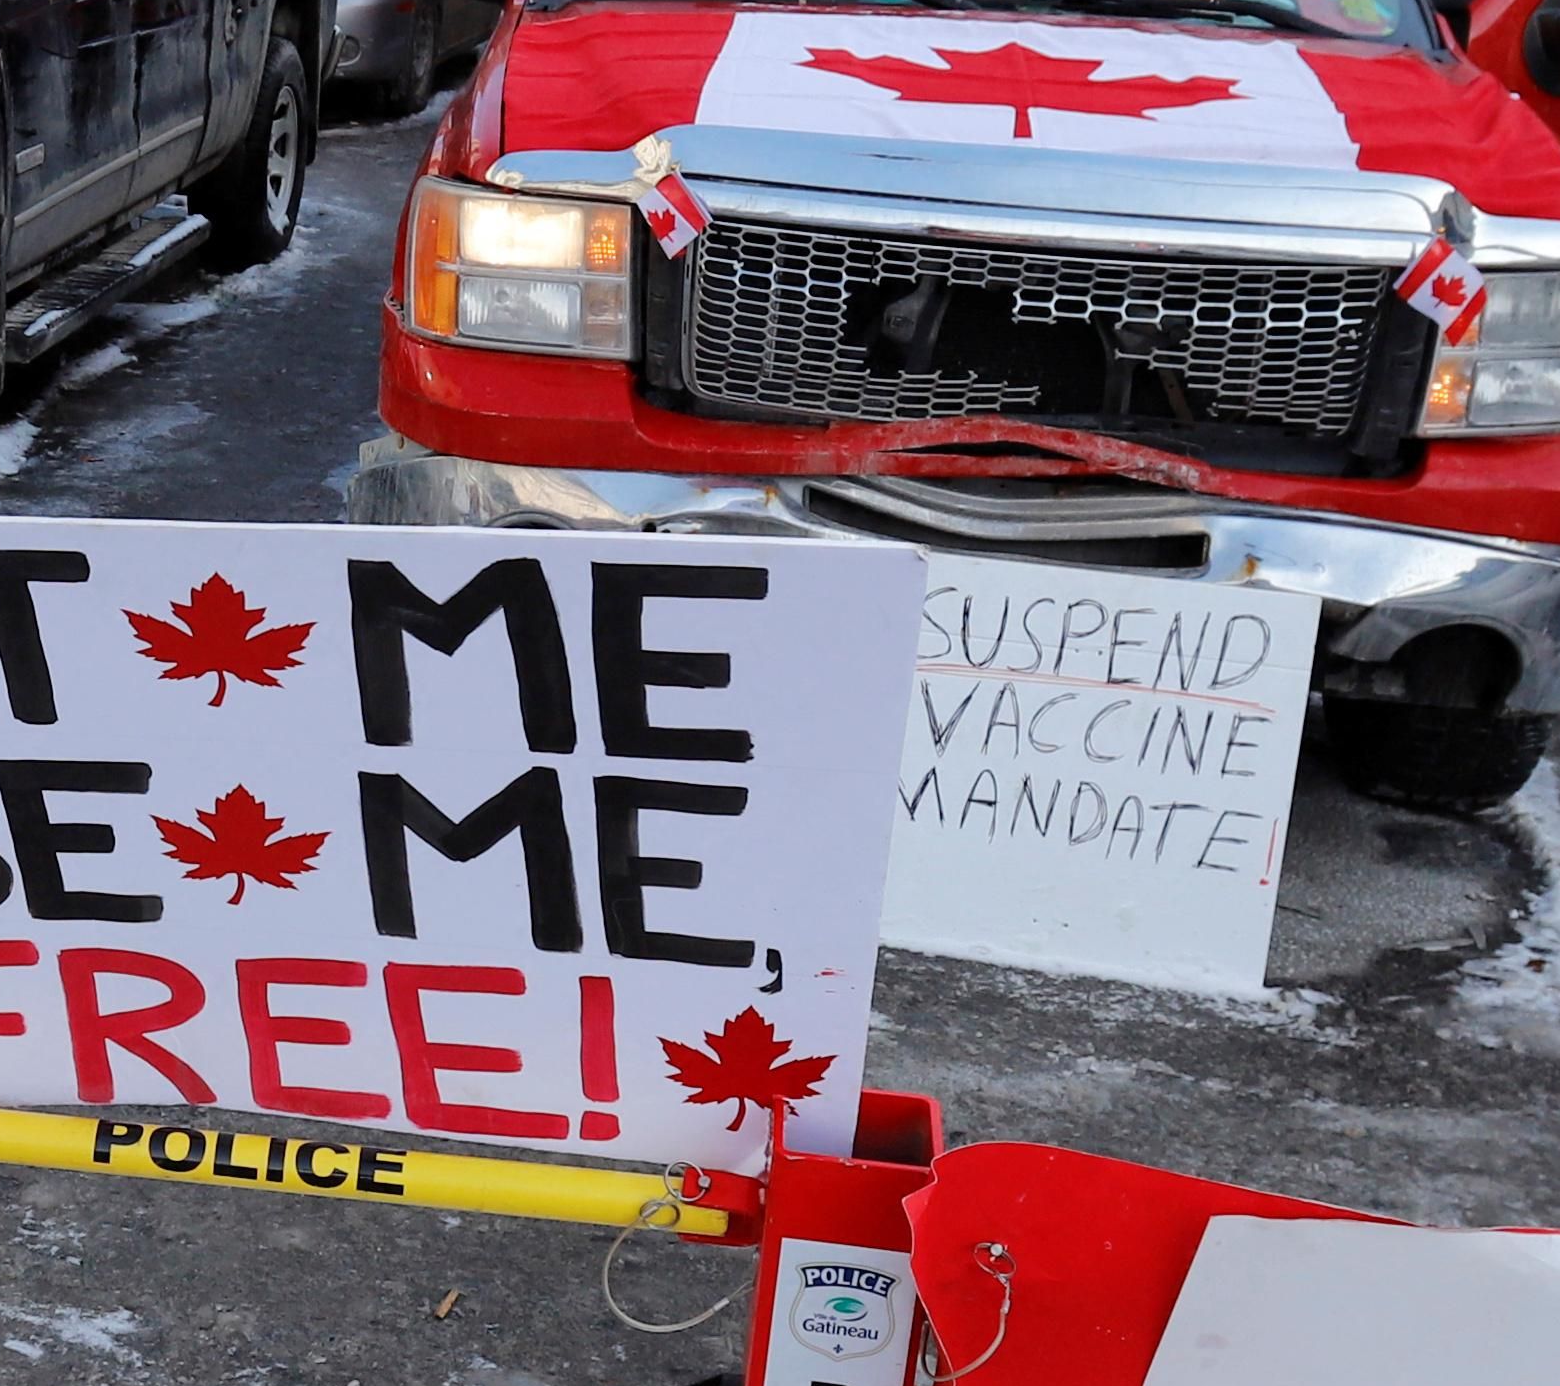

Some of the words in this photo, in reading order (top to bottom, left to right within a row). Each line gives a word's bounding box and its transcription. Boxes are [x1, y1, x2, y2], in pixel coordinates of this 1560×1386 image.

[346, 556, 772, 763] ME
[916, 585, 1272, 692] SUSPEND
[920, 679, 1274, 779] VACCINE
[358, 765, 784, 997] ME,
[92, 1120, 409, 1198] POLICE
[801, 1317, 880, 1341] Gatineau
[804, 1267, 893, 1296] POLICE
